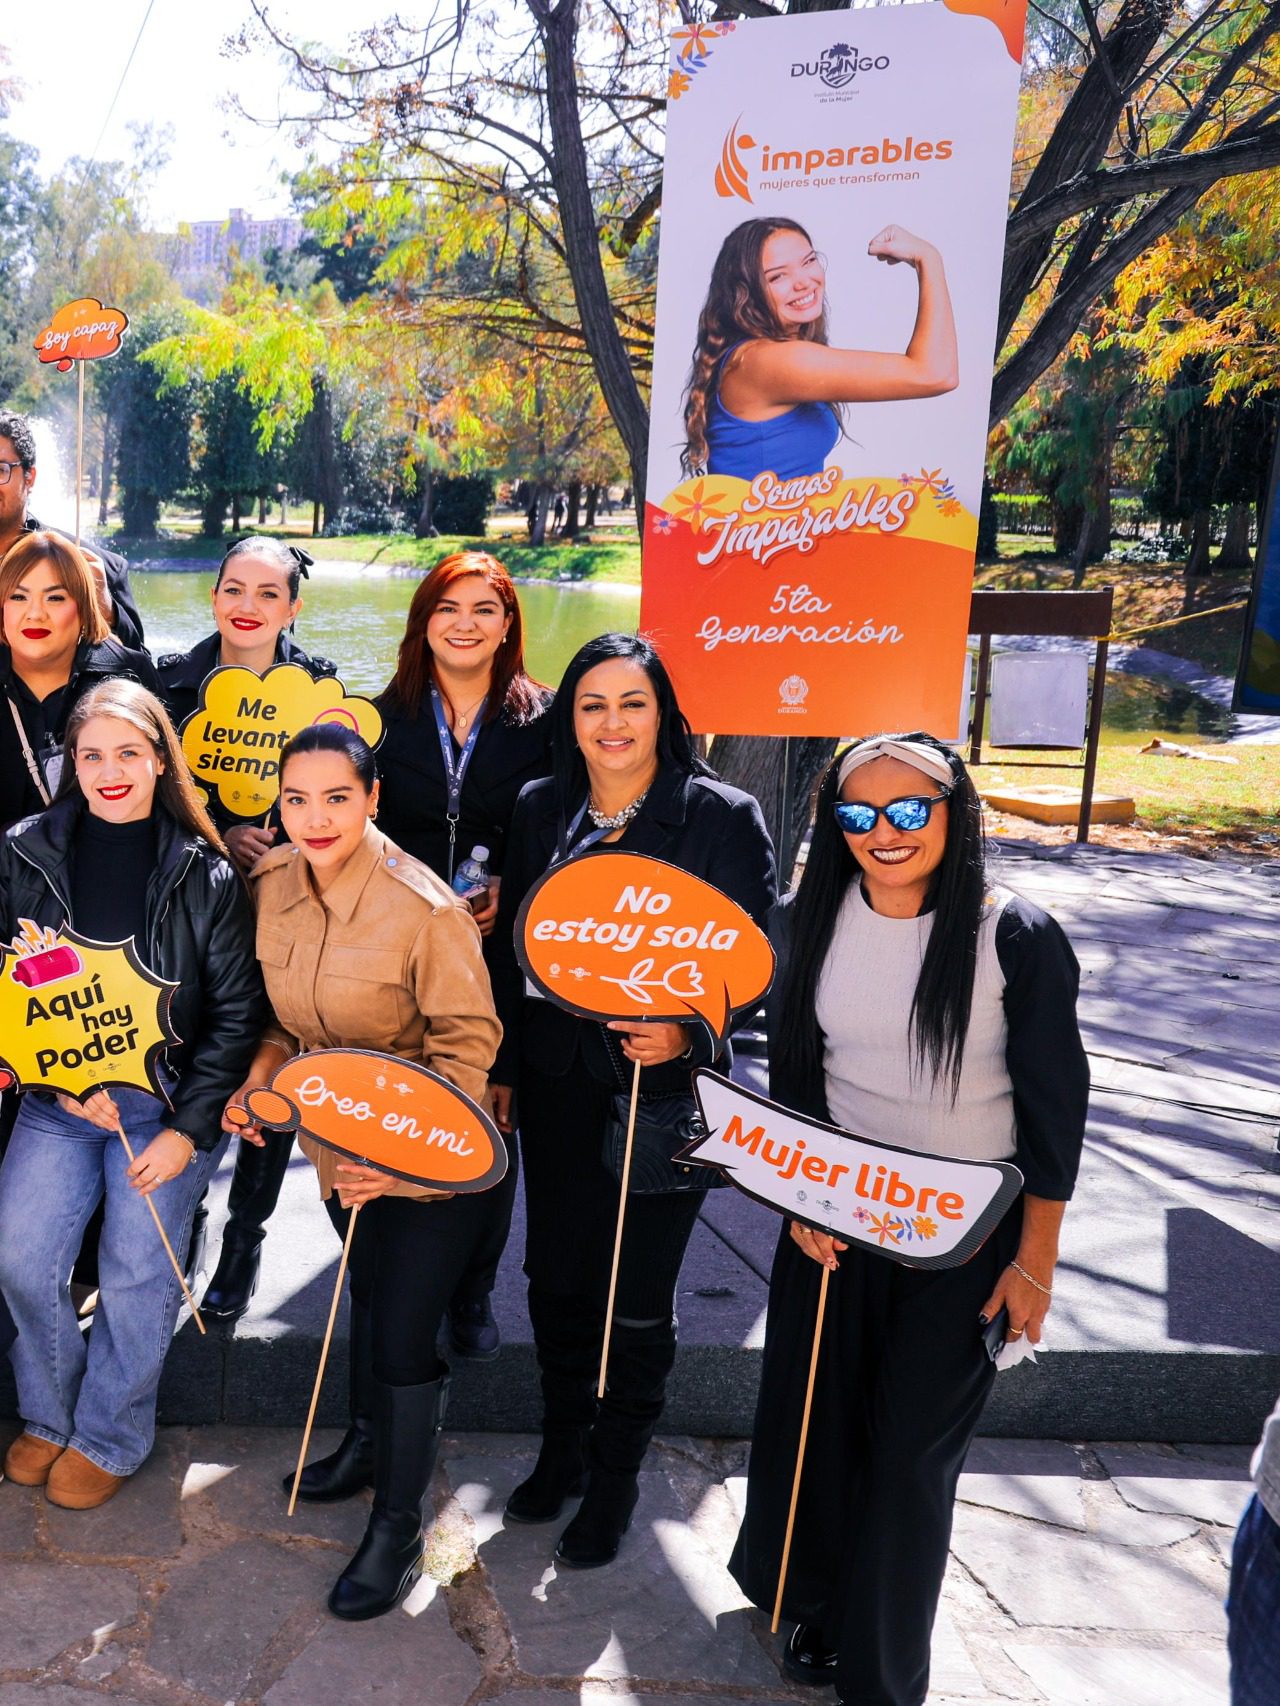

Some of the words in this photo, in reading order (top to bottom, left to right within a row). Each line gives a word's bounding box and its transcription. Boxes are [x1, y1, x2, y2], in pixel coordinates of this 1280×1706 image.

[762, 137, 953, 174] imparables
[759, 177, 811, 192] mujeres
[812, 175, 837, 189] que
[839, 169, 920, 185] transforman
[74, 321, 119, 342] capaz
[742, 468, 839, 513] Somos
[696, 487, 914, 565] Imparables
[770, 584, 832, 614] 5ta
[695, 615, 904, 652] Generación
[237, 697, 277, 720] Me
[203, 721, 290, 749] levant
[197, 748, 279, 781] siemp
[613, 885, 671, 915] No
[533, 917, 645, 953] estoy
[648, 920, 740, 951] sola
[26, 973, 105, 1027] Aquí
[81, 1005, 133, 1033] hay
[35, 1027, 140, 1078] Poder
[294, 1075, 376, 1120] Creo
[381, 1111, 423, 1139] en
[426, 1127, 474, 1157] mi
[722, 1115, 850, 1188] Mujer
[854, 1163, 965, 1220] libre
